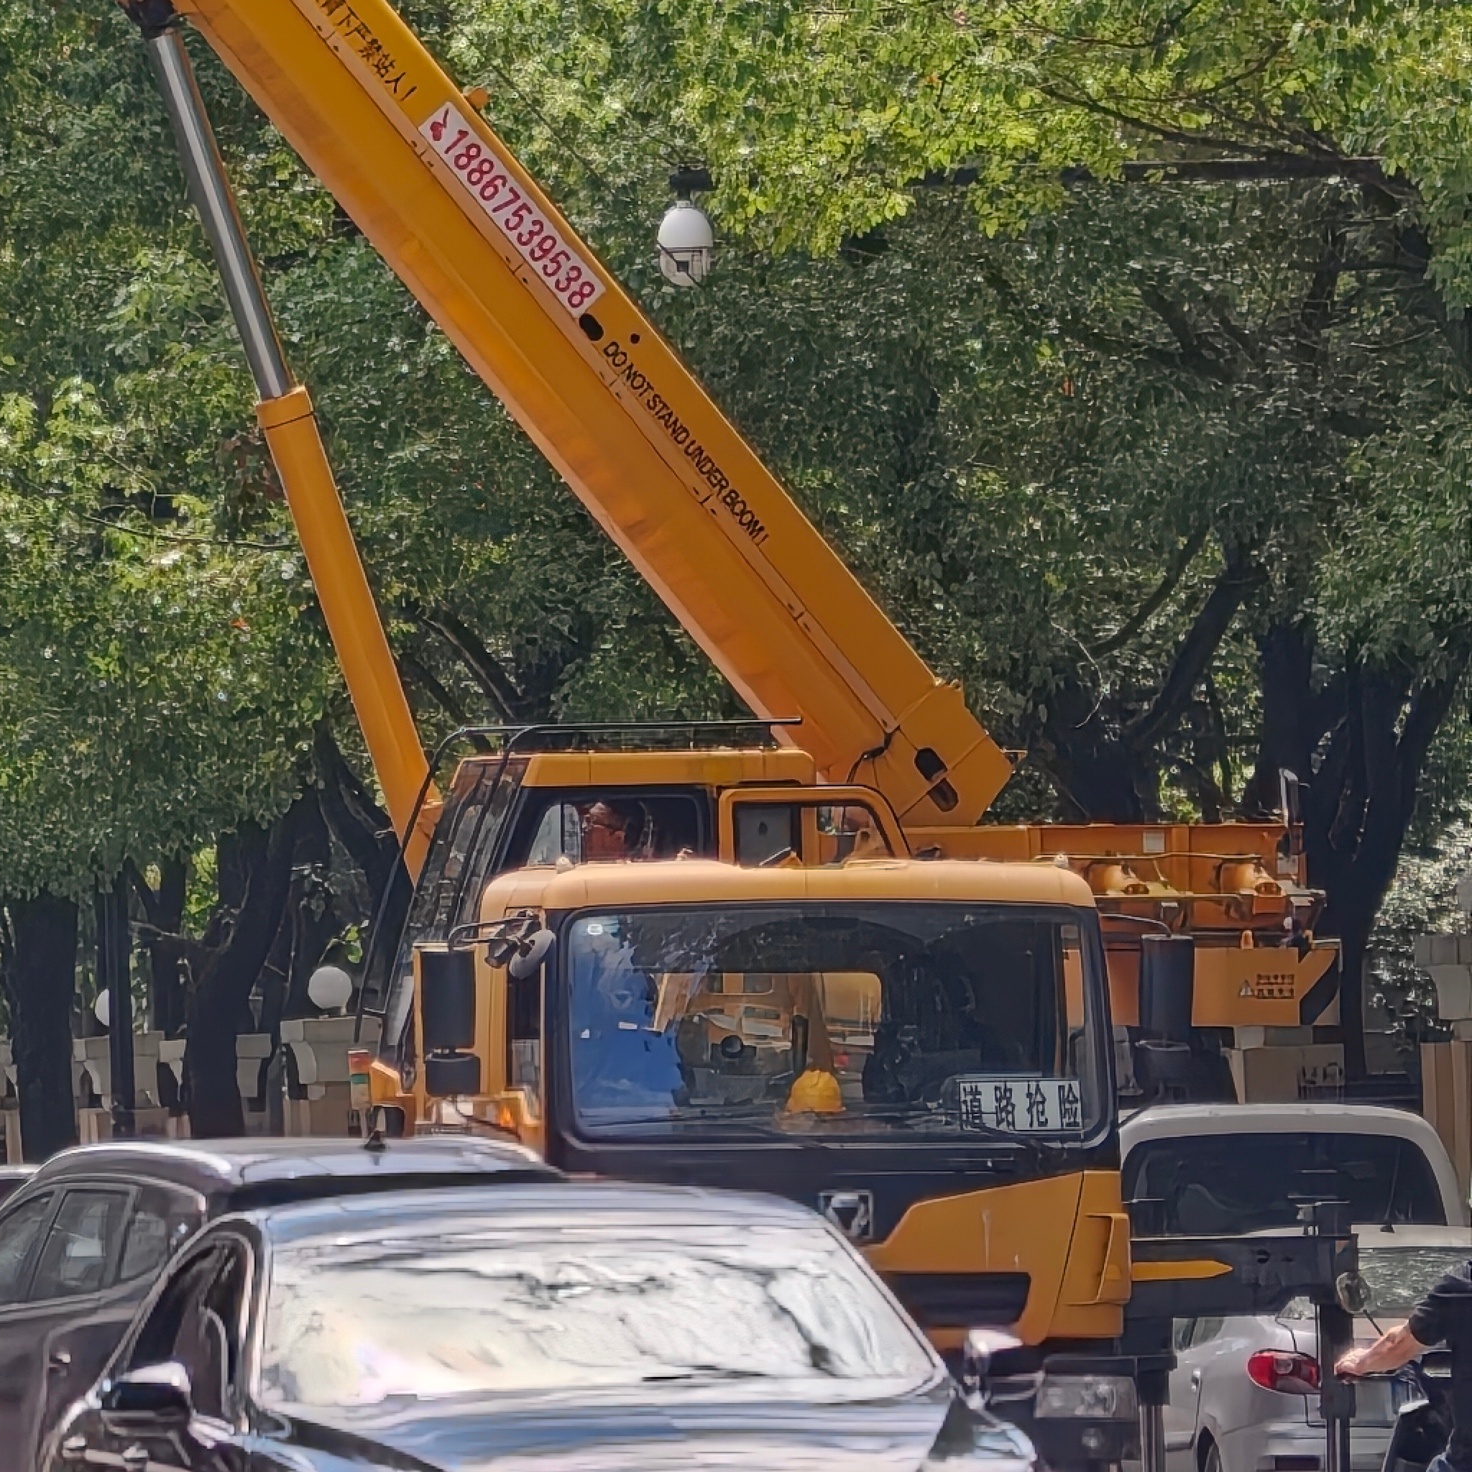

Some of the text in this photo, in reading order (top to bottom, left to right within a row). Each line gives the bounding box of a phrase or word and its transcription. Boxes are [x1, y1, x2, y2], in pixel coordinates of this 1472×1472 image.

[443, 128, 596, 309] 18867539538
[603, 341, 628, 368] DO
[620, 362, 655, 398] NOT
[646, 393, 691, 446] STAND
[683, 439, 730, 497] UNDER
[960, 1080, 1080, 1130] 道路抢险
